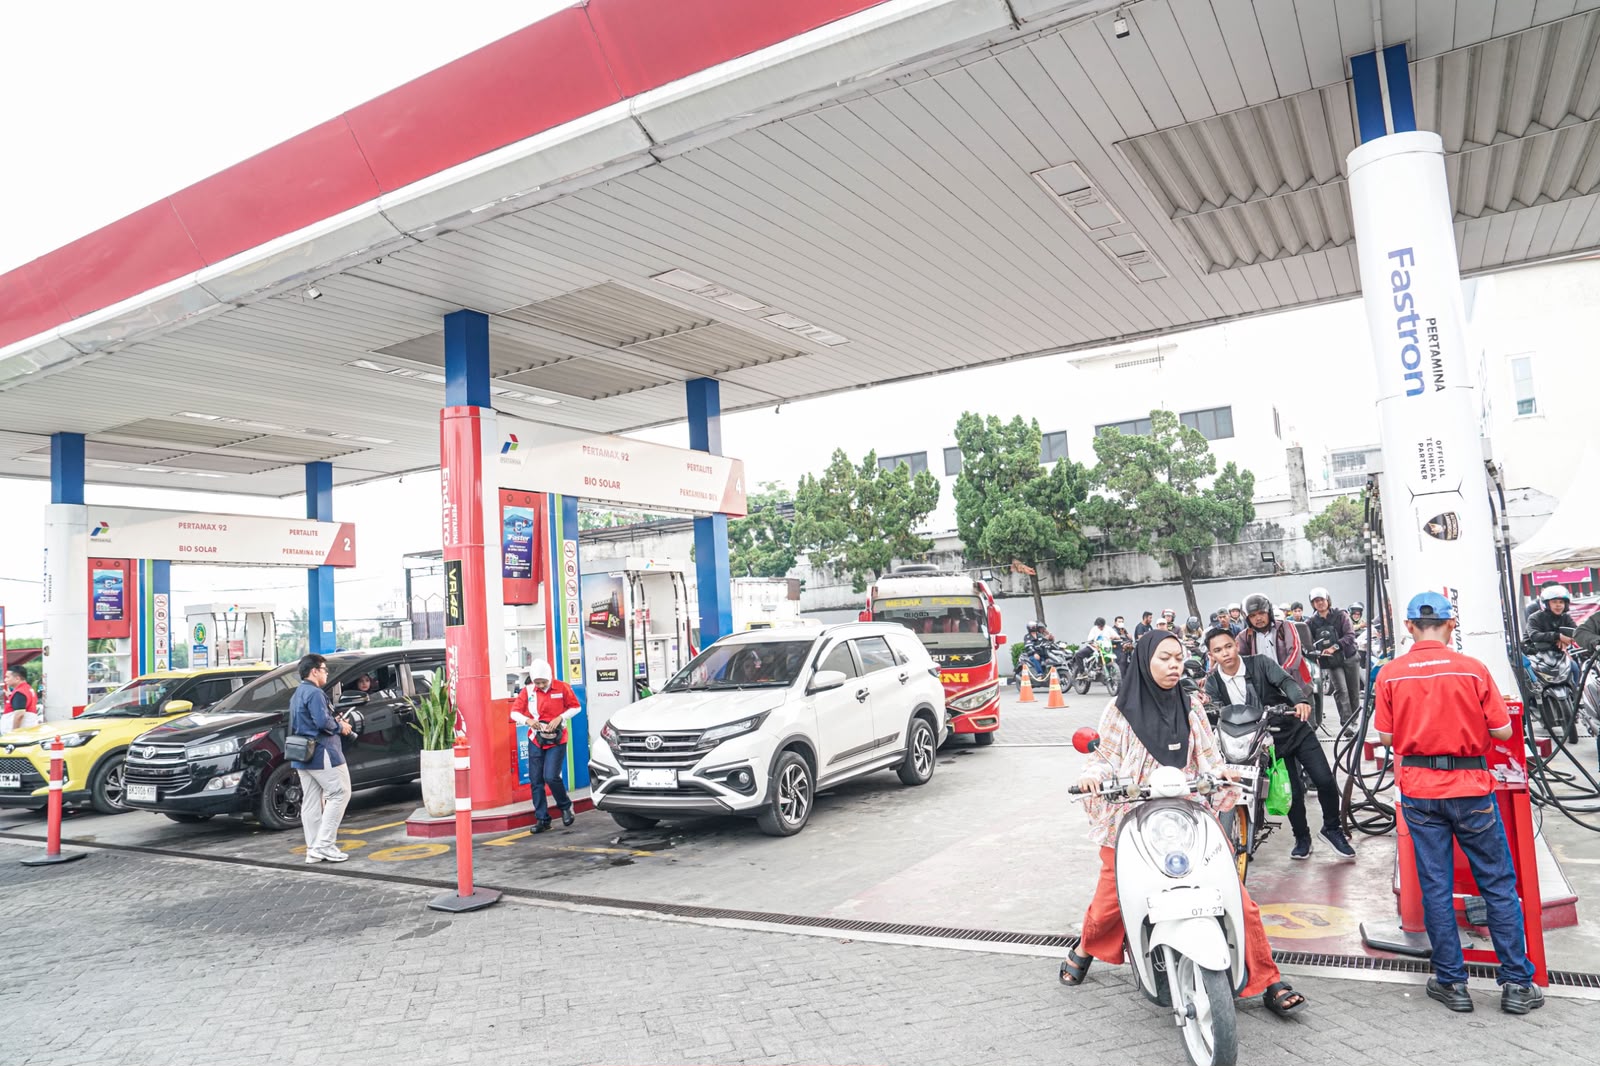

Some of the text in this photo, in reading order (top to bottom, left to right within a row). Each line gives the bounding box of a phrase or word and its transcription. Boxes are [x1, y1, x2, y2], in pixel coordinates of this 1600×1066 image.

[1387, 247, 1426, 397] Fastron
[1426, 317, 1446, 392] PERTAMINA
[582, 445, 630, 462] PERTAMAX 92
[1418, 442, 1428, 480] PARTNER
[1426, 437, 1437, 483] TECHNICAL
[1436, 440, 1446, 478] OFFICIAL
[686, 463, 713, 475] PERTALITE
[584, 476, 621, 490] BIO SOLAR
[735, 477, 743, 495] 4
[442, 467, 451, 547] Enduro
[178, 522, 217, 531] PERTAMAX
[194, 545, 217, 553] SOLAR
[282, 548, 314, 556] PERTAMINA
[343, 538, 351, 551] 2
[1450, 587, 1464, 655] PERTAMA
[1192, 906, 1223, 916] 07 27
